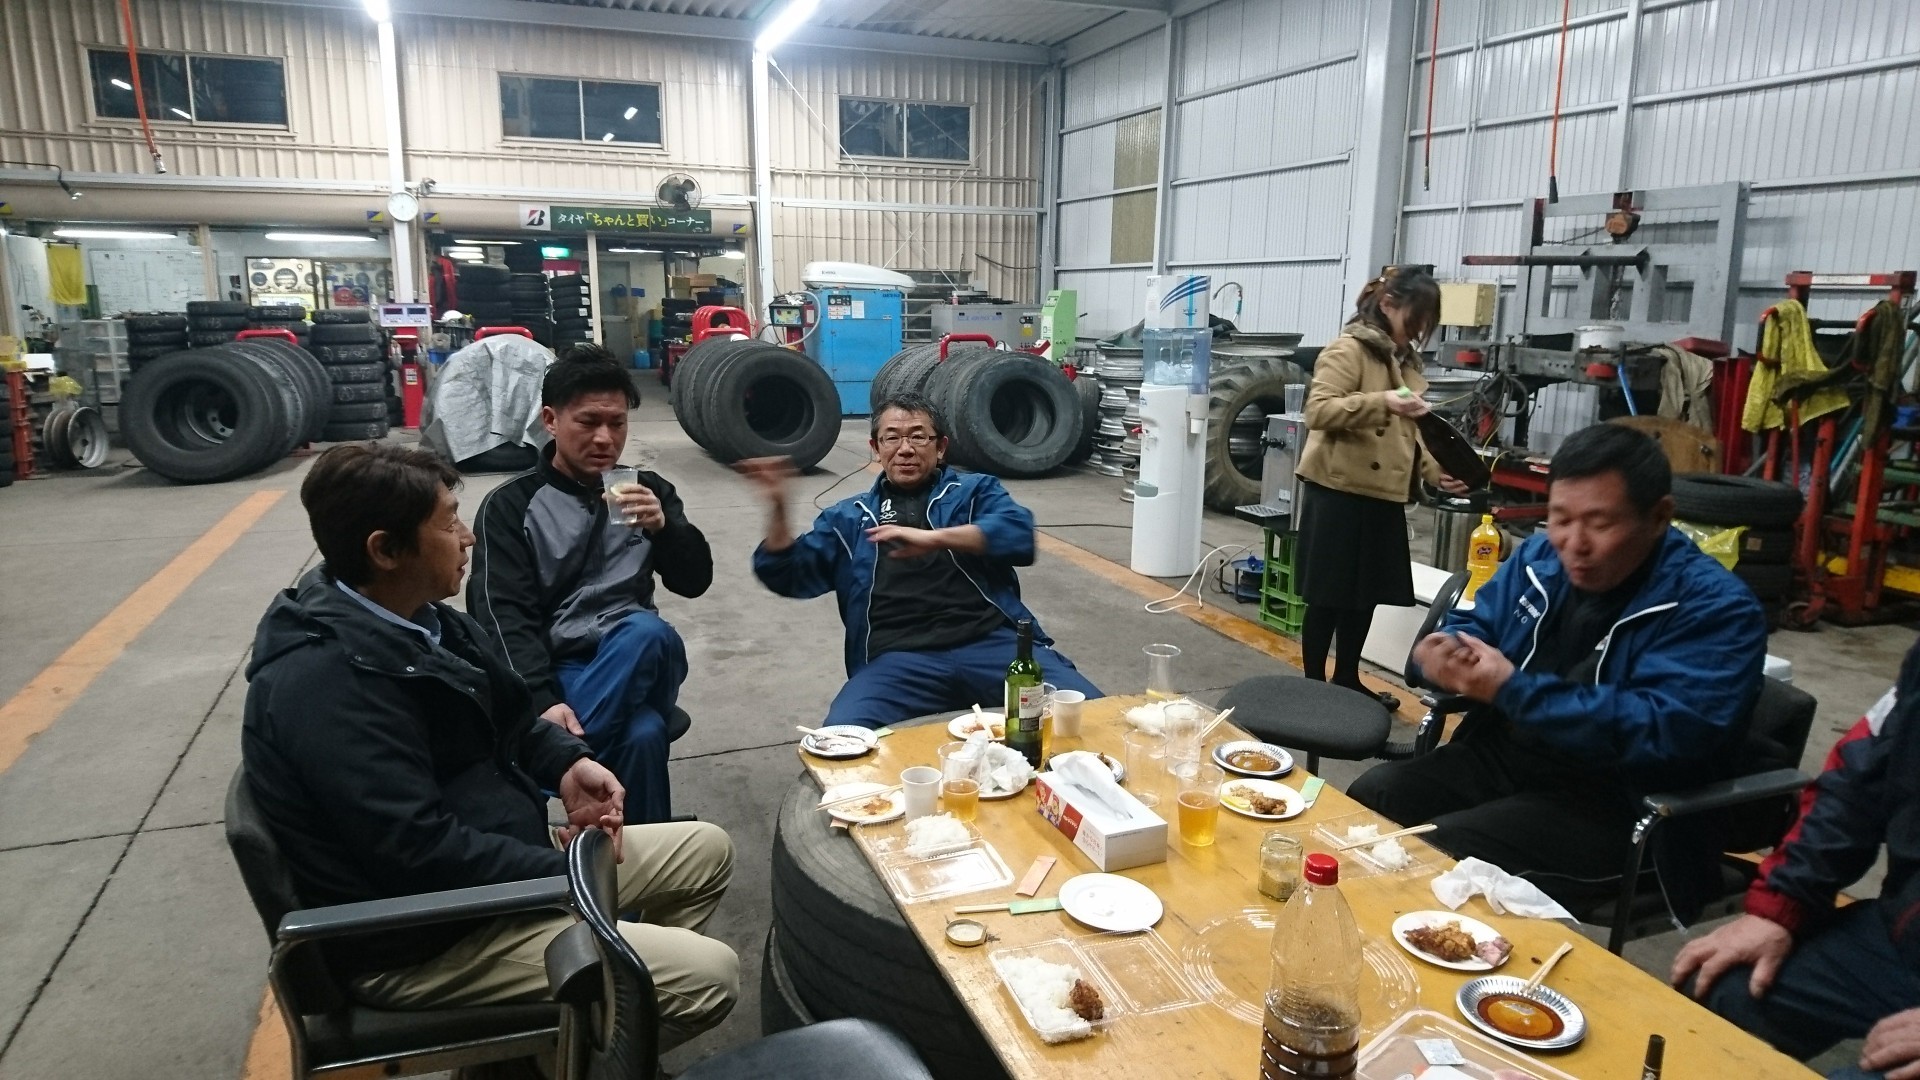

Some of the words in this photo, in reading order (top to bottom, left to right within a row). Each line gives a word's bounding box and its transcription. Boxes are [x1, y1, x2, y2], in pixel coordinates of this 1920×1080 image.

[557, 211, 705, 228] タイヤ「ちゃんと買い」コーナー
